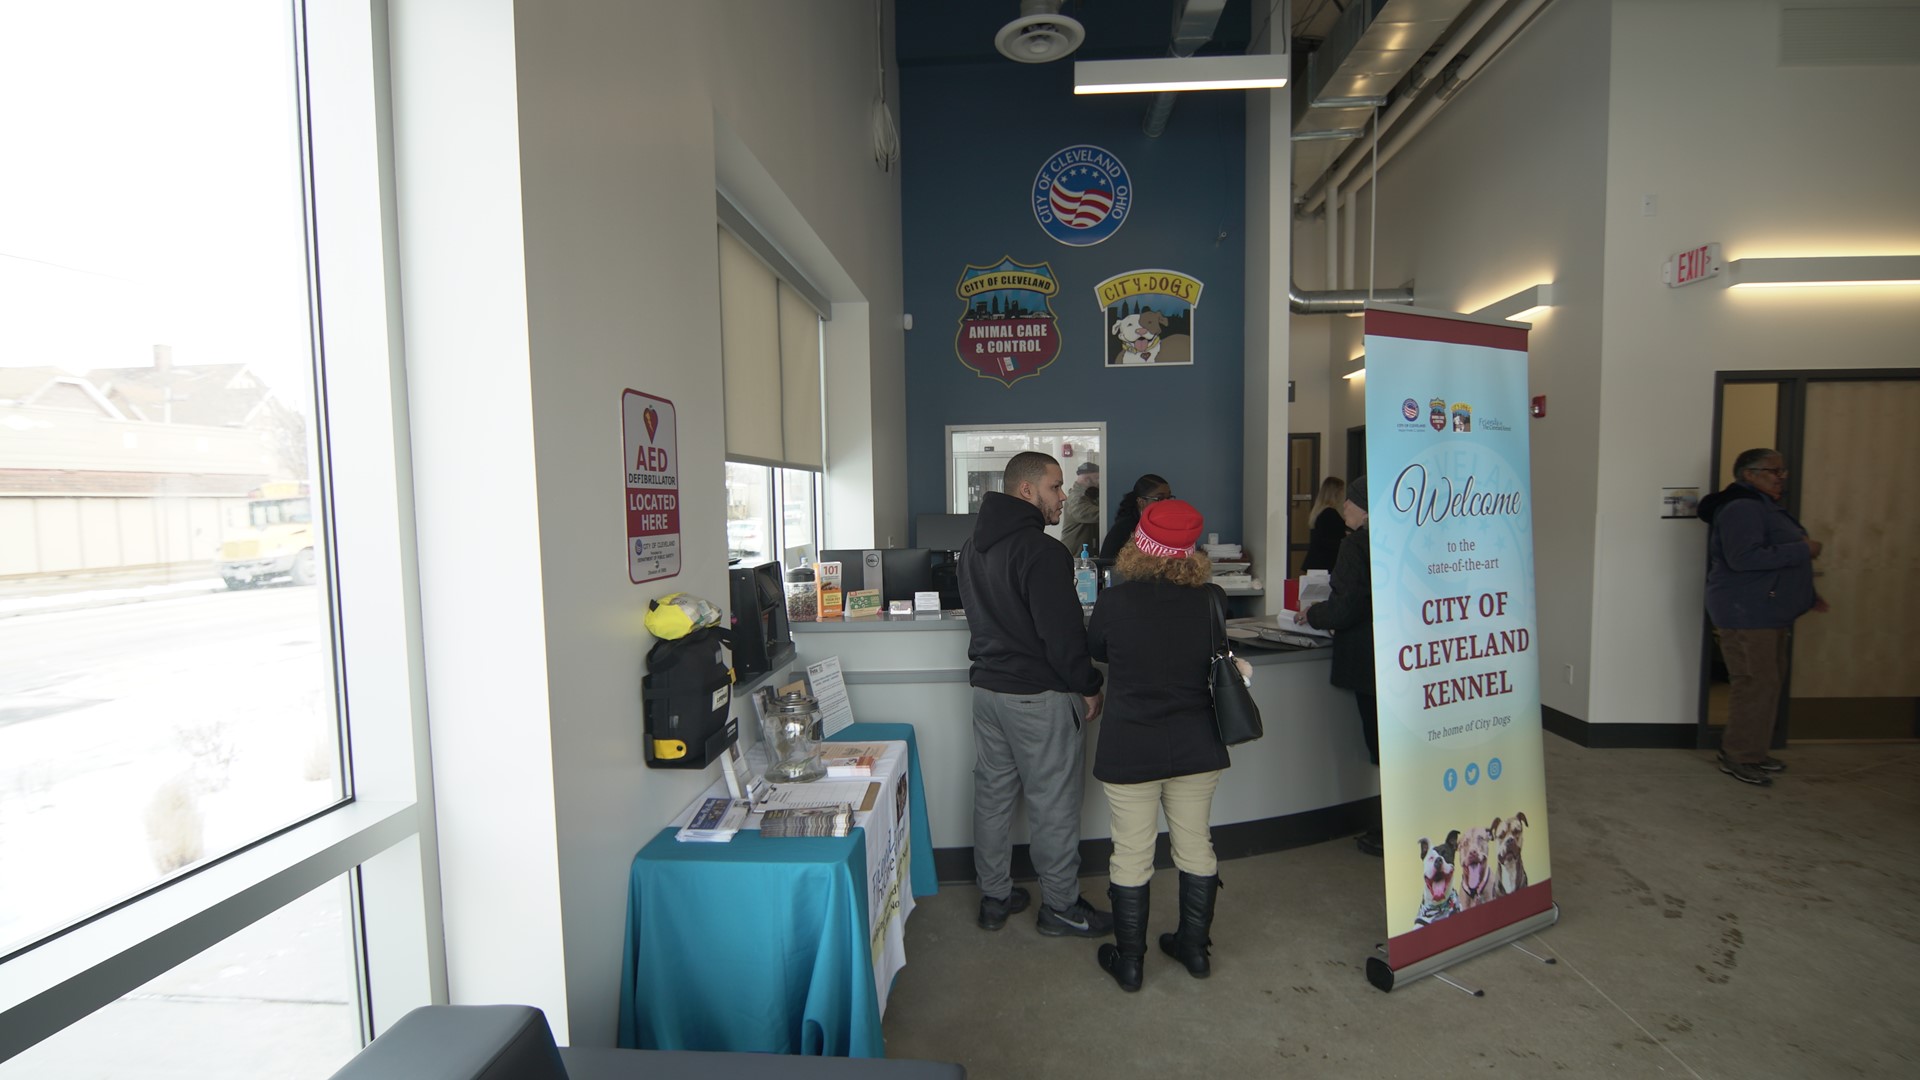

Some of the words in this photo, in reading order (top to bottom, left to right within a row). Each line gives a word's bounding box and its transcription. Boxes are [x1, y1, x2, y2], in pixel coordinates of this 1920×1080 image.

[1050, 149, 1121, 178] CLEVELAND
[1038, 172, 1052, 190] OF
[1036, 195, 1053, 223] CITY
[1111, 185, 1128, 220] OHIO
[1677, 245, 1708, 283] EXIT
[963, 279, 985, 293] CITY
[987, 276, 998, 287] OF
[1001, 275, 1051, 291] CLEVELAND
[969, 325, 1013, 339] ANIMAL
[1016, 324, 1047, 337] CARE
[975, 342, 984, 354] &
[987, 339, 1041, 354] CONTROL
[636, 445, 668, 473] AED
[628, 473, 676, 486] DEFIBRILLATOR
[630, 493, 676, 511] LOCATED
[1392, 463, 1521, 527] Welcome
[641, 513, 668, 531] HERE
[1447, 541, 1457, 552] to
[1459, 538, 1476, 551] the
[823, 565, 839, 575] 101
[1427, 557, 1499, 575] state-of-the-art
[1421, 595, 1471, 626] CITY
[1478, 591, 1508, 618] OF
[1398, 628, 1529, 672] CLEVELAND
[1422, 670, 1513, 710] KENNEL
[1427, 729, 1442, 742] The
[1442, 725, 1464, 738] home
[1465, 721, 1475, 733] of
[1475, 717, 1491, 731] City
[1493, 714, 1511, 727] Dogs
